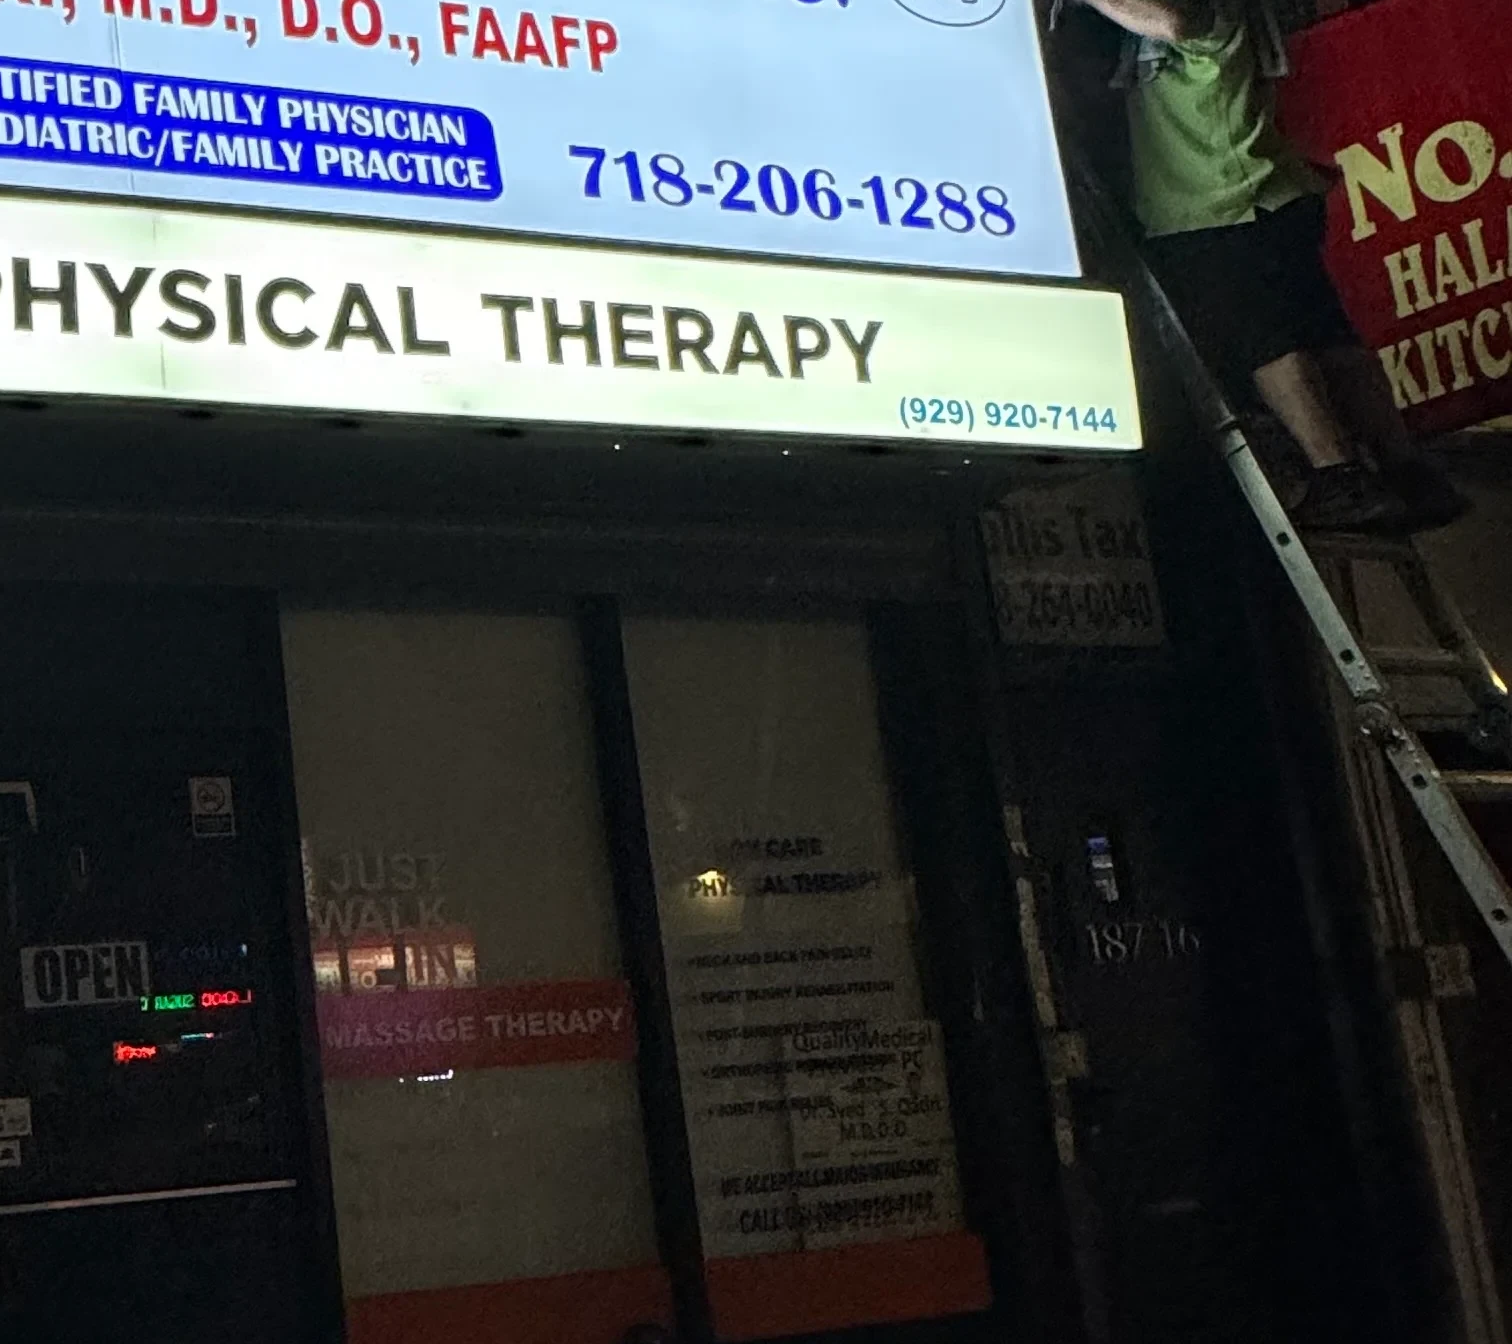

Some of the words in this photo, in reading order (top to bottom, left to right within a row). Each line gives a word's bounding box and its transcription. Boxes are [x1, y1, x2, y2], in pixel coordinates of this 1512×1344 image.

[439, 2, 618, 72] FAAFP
[133, 82, 267, 126] FAMILY
[277, 97, 468, 147] PHYSICIAN
[314, 143, 492, 190] PRACTICE
[569, 145, 1016, 236] 718-206-1288
[1384, 206, 1512, 318] HAL
[483, 294, 881, 381] THERAPY
[1378, 301, 1512, 409] KITC
[899, 396, 975, 433] (929)
[984, 402, 1118, 433] 920-7144
[33, 944, 144, 1004] OPEN
[325, 1014, 477, 1050] MASSAGE
[483, 1005, 625, 1040] THERAPY
